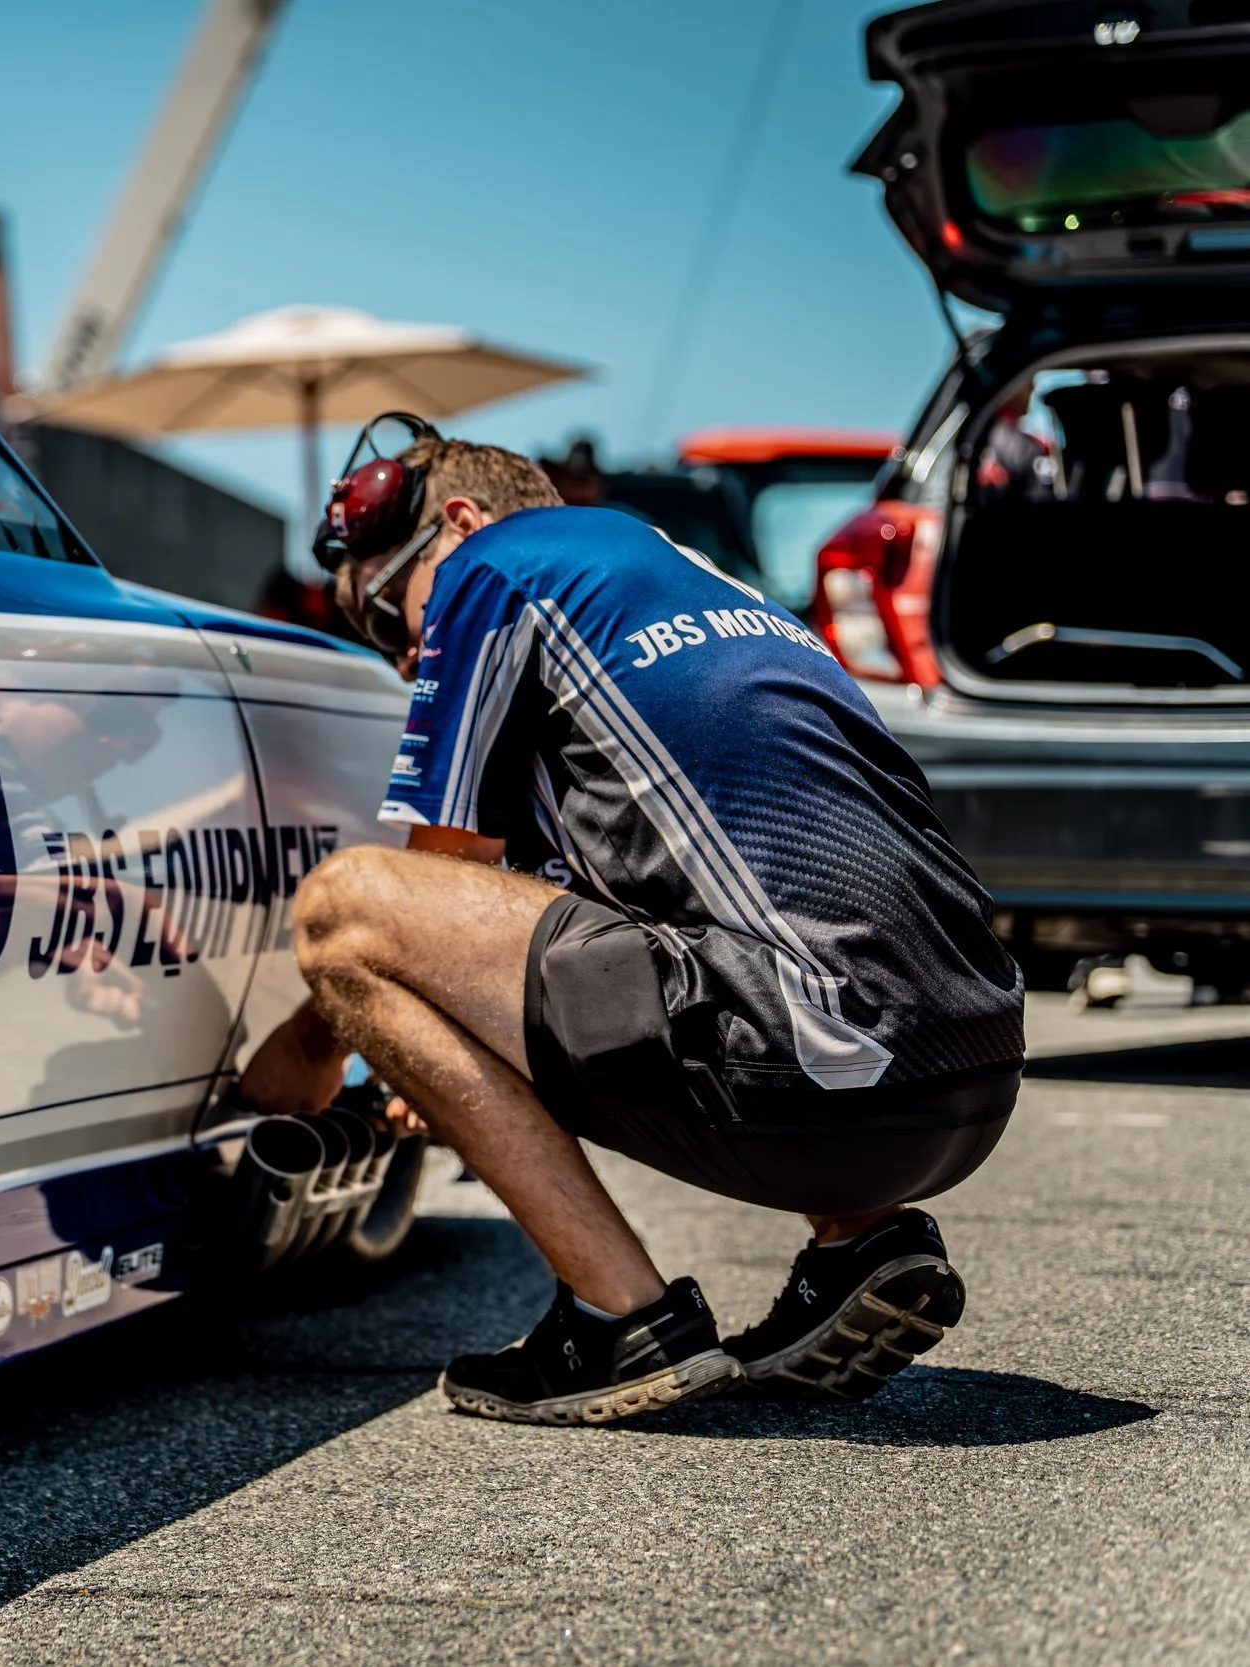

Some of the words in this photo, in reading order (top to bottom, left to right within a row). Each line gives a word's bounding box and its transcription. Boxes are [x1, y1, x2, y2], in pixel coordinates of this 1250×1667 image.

[624, 613, 707, 669] JBS
[702, 608, 841, 664] MOTORS
[28, 828, 128, 980] JBS
